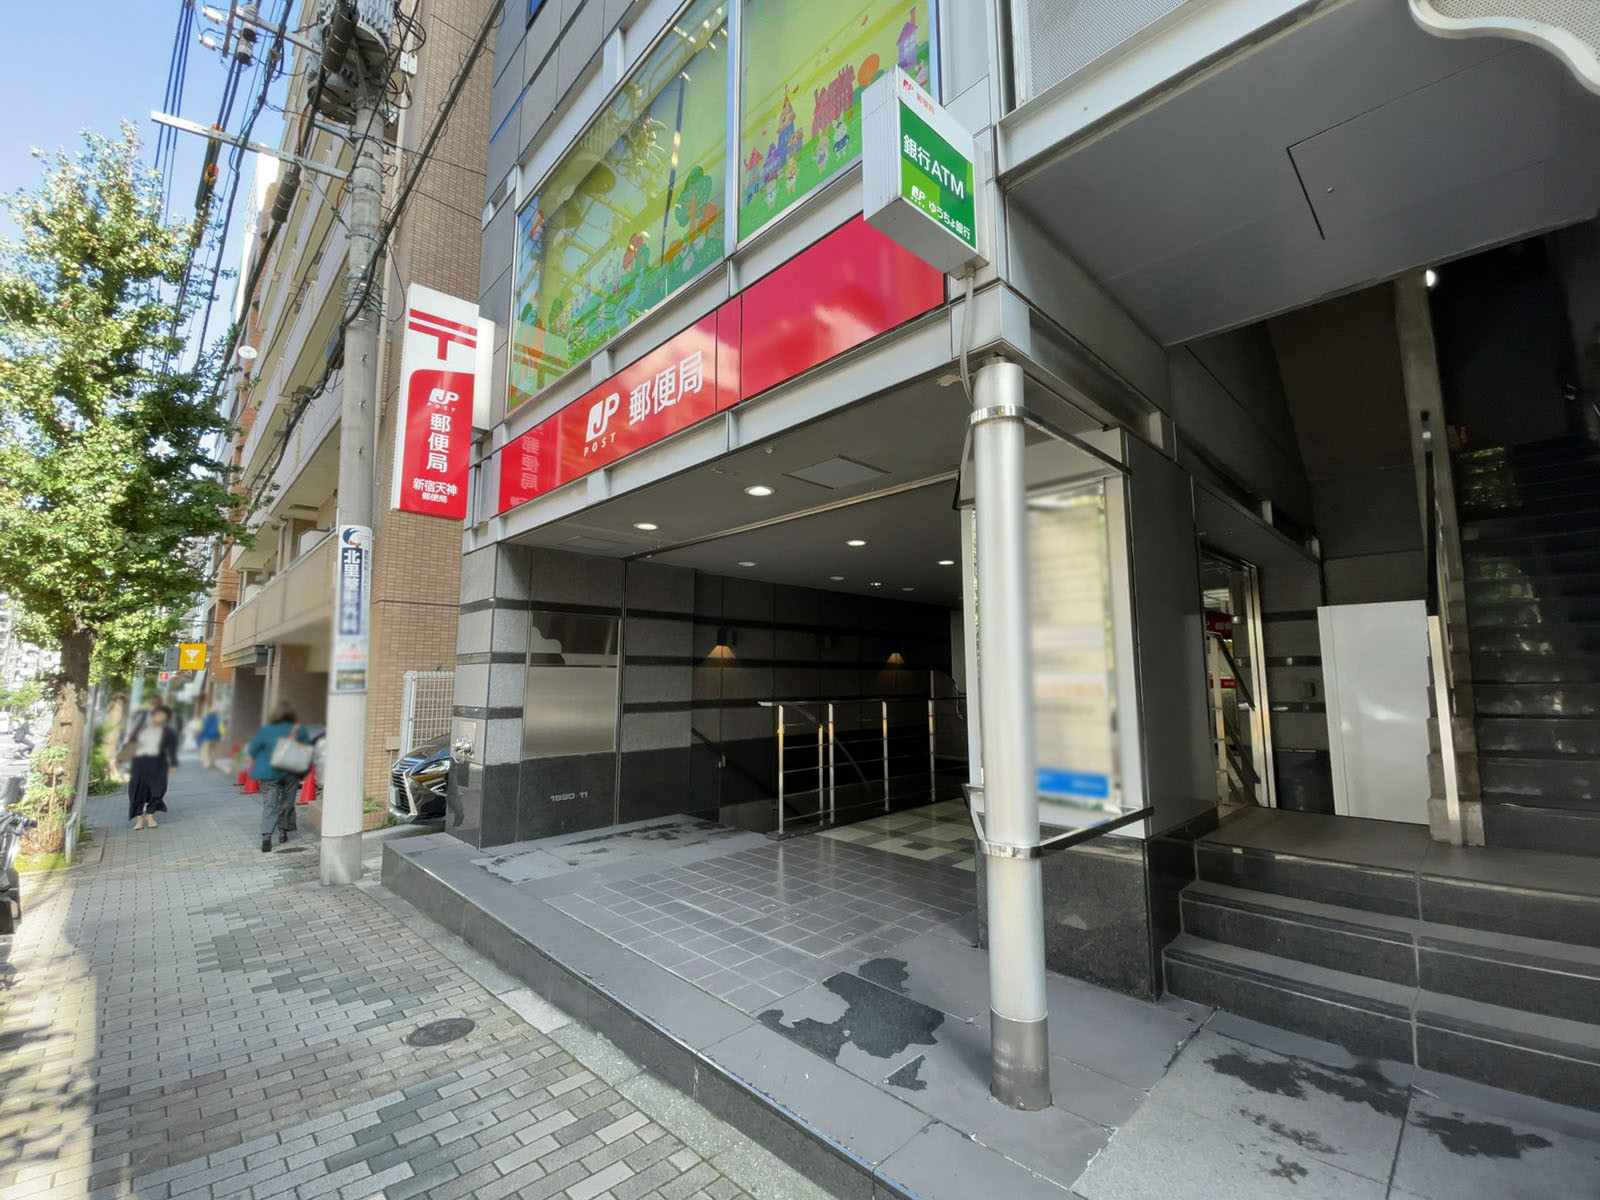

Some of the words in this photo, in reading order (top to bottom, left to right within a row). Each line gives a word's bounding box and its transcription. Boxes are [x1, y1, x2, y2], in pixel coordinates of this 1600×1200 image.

[903, 134, 964, 199] 銀行ATM
[928, 200, 970, 240] ゆうちょ銀行
[629, 349, 703, 426] 郵便局
[427, 402, 456, 412] POST
[426, 413, 451, 473] 郵便局
[583, 432, 616, 457] POST
[412, 477, 458, 496] 新宿天神
[422, 492, 448, 503] 郵便局
